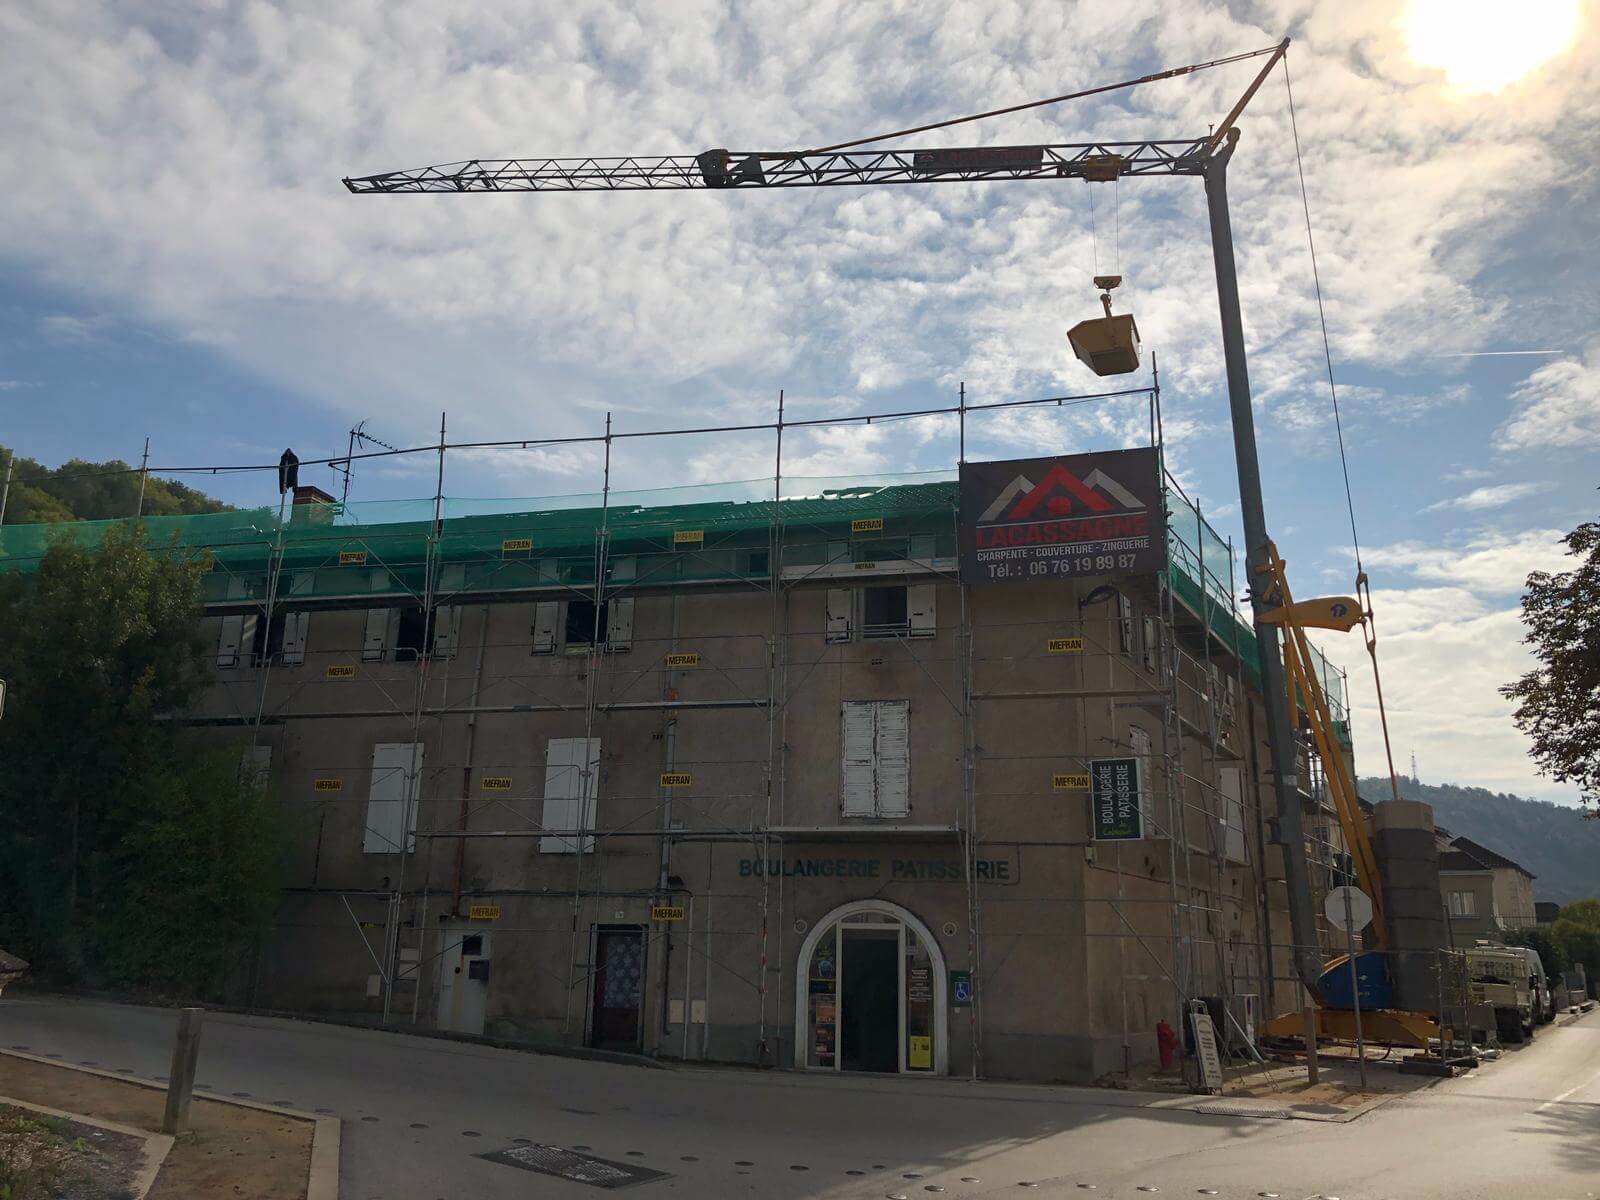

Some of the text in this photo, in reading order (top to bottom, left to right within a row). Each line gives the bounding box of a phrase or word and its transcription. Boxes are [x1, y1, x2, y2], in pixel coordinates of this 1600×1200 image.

[852, 519, 882, 530] MEFRAN
[977, 549, 1027, 562] CHARPENTE
[1036, 545, 1093, 557] COUVERTURE
[1102, 538, 1149, 551] ZINGUERIE
[1029, 560, 1047, 575] 06
[1051, 559, 1070, 573] 76
[1074, 557, 1092, 571] 19
[1095, 555, 1115, 570] 89
[1118, 553, 1136, 568] 87
[1049, 640, 1082, 650] MEFRAN
[668, 655, 696, 665] MEFRAN
[327, 667, 353, 676] MEFRAN
[314, 780, 341, 790] MEFRAN
[482, 778, 511, 788] MEFRAN
[661, 775, 690, 785] MEFRAN
[1054, 777, 1088, 787] MEFRAN
[1100, 765, 1113, 824] BOULANGERIE
[1117, 764, 1131, 818] PATISSERIE
[739, 859, 880, 877] BOULANGERIE
[654, 908, 683, 918] MEFRAN
